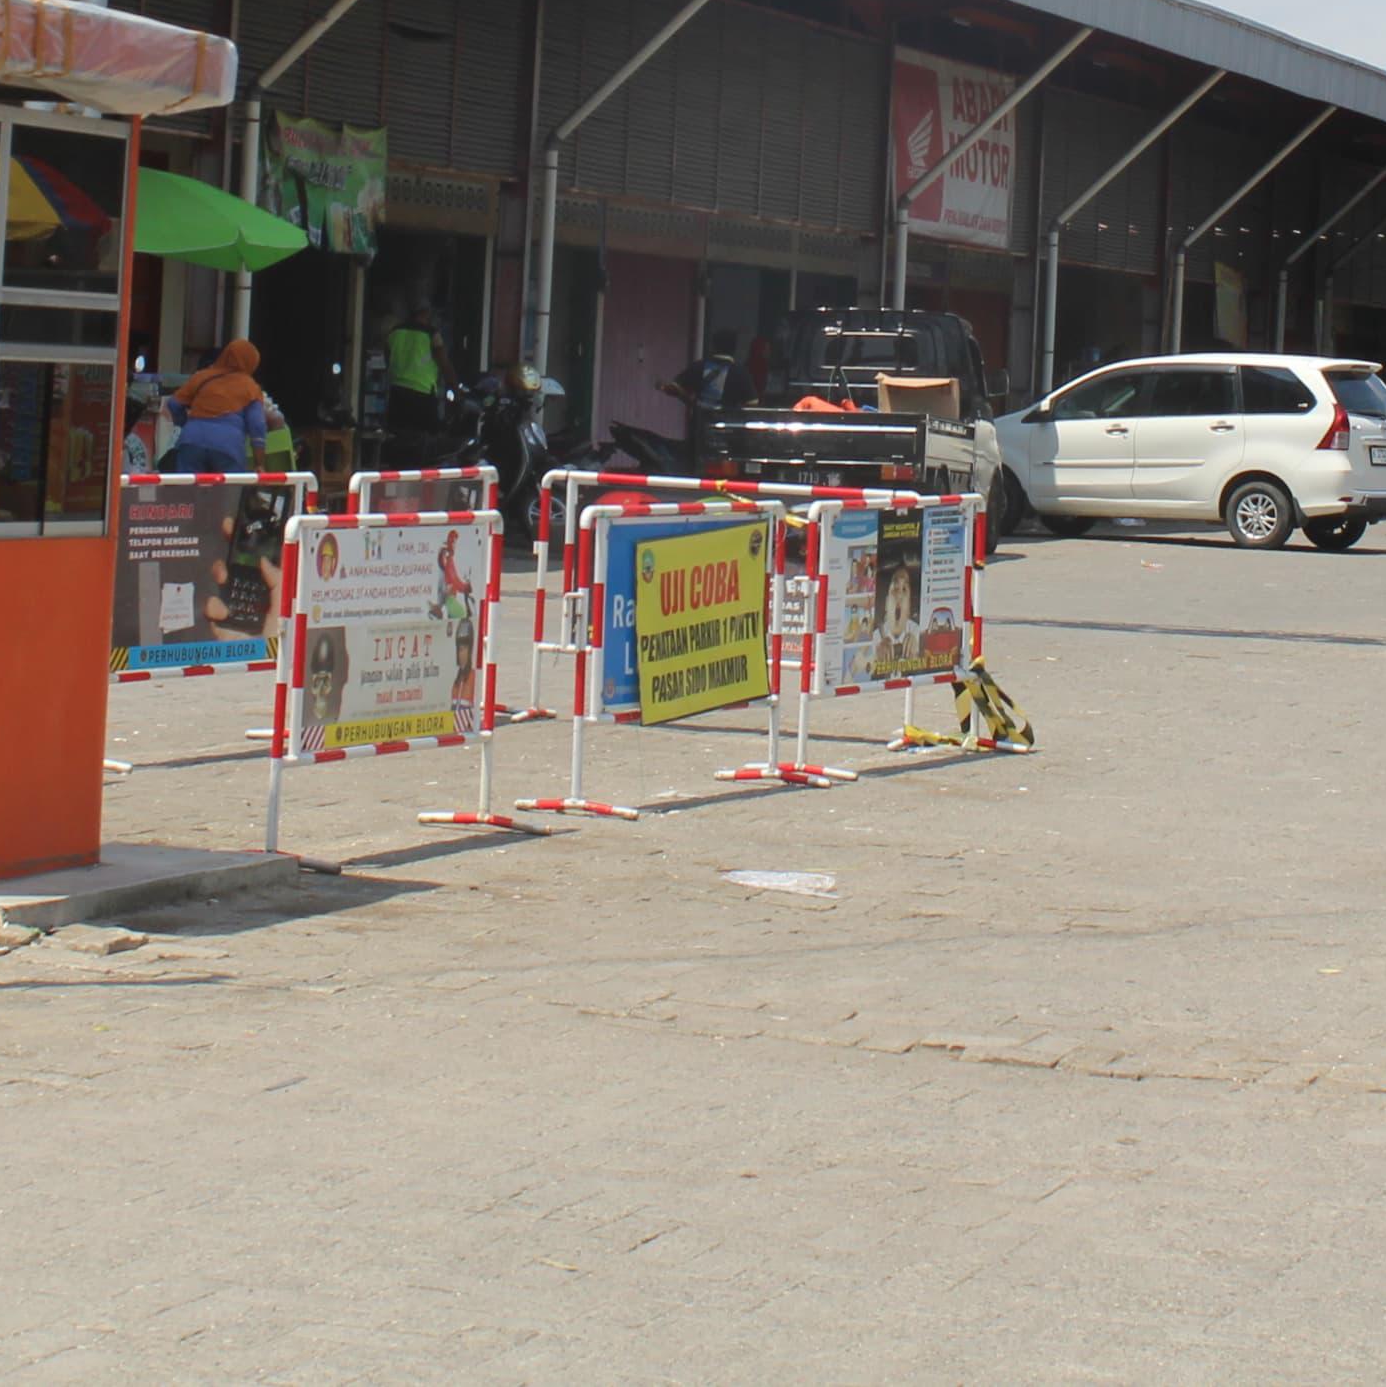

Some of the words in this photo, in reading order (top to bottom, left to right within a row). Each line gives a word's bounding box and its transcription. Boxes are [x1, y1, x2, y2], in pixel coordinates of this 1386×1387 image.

[948, 131, 1011, 190] MOTOR
[660, 569, 686, 616] UJI
[690, 559, 741, 610] COBA
[149, 646, 222, 663] PERHUBUNGAN
[225, 643, 256, 658] BLORA
[373, 634, 432, 662] INGAT
[641, 627, 688, 663] PENATAAN
[690, 619, 722, 652] PARKIR
[729, 611, 760, 643] PINTU
[652, 671, 684, 704] PASAR
[686, 663, 707, 696] SIDO
[708, 655, 749, 691] MAKMUR
[343, 721, 413, 743] PERHUBUNGAN
[416, 717, 445, 734] BLORA
